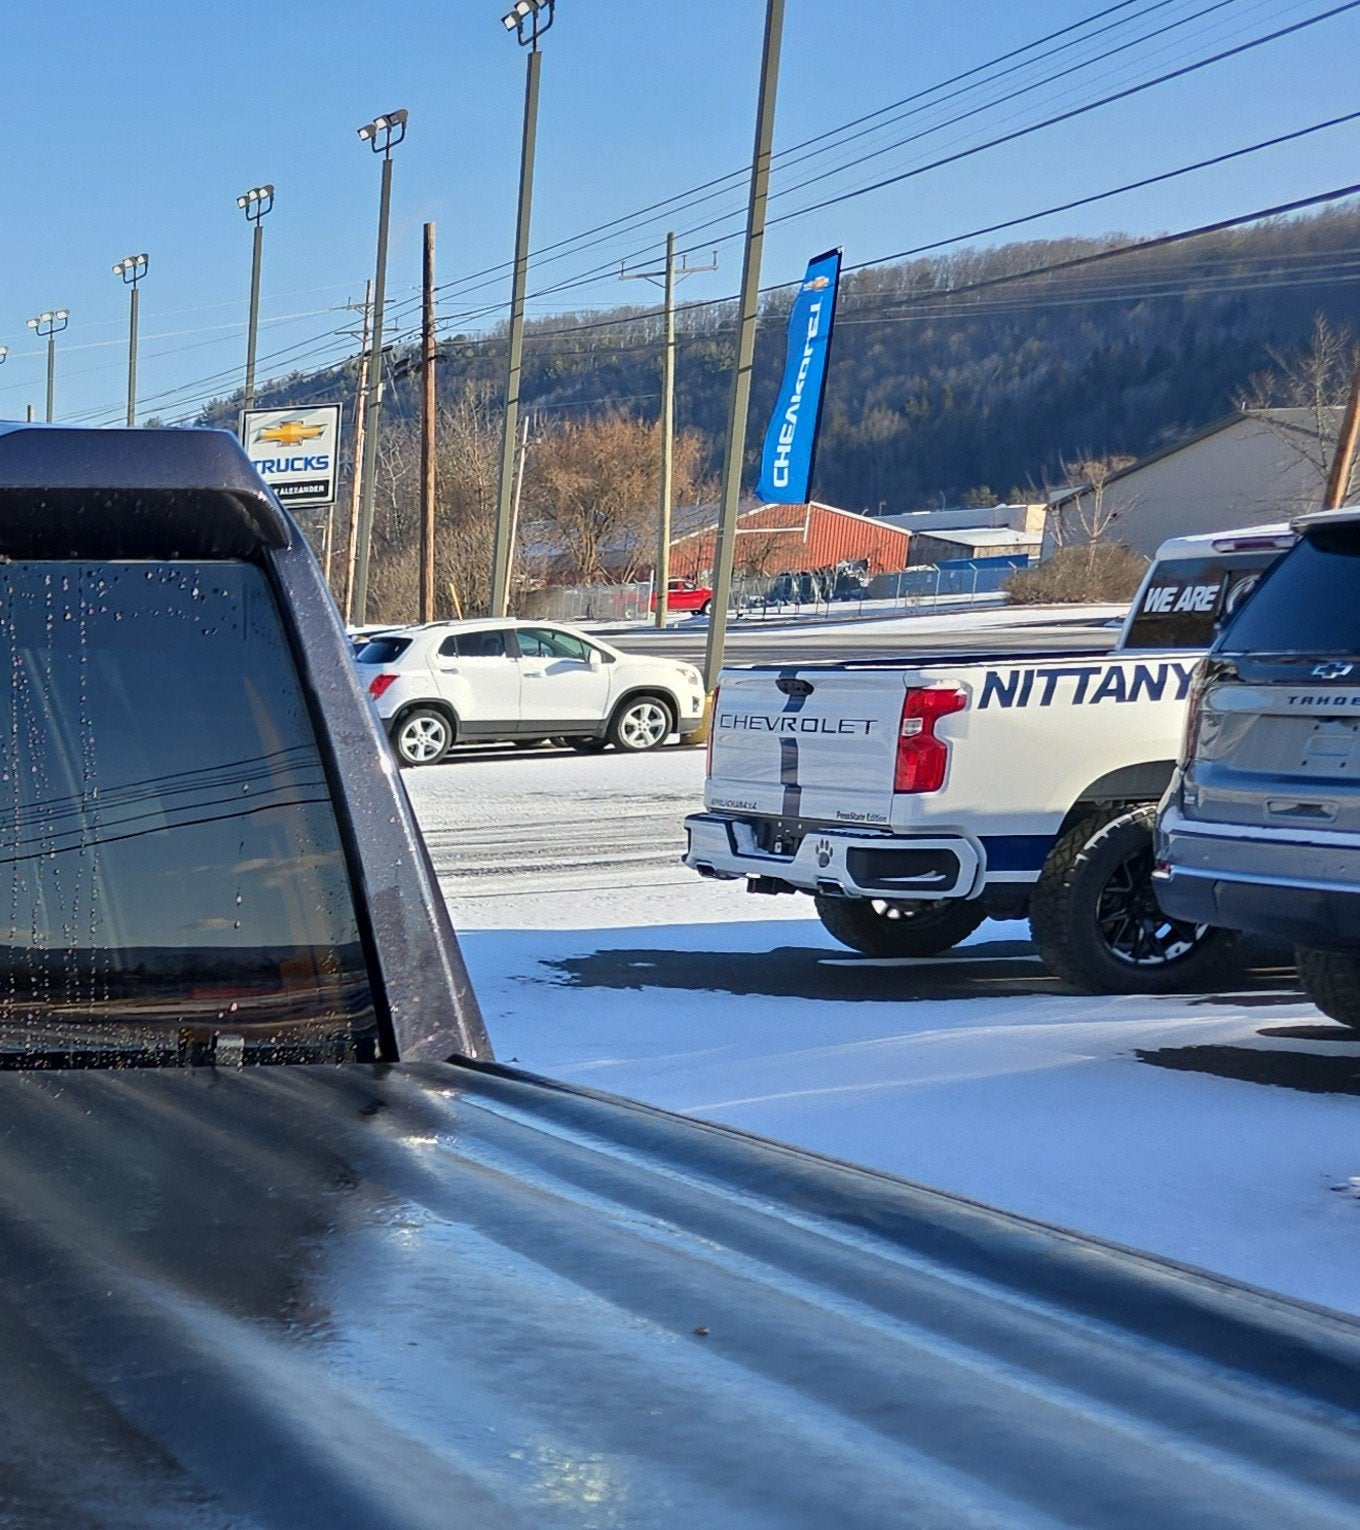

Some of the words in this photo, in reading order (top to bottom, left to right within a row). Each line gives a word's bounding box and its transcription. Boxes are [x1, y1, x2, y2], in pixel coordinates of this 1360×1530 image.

[280, 484, 325, 496] ALEXANDER
[1143, 586, 1179, 613] WE
[1173, 585, 1221, 613] ARE
[977, 662, 1195, 710] NITTANY
[719, 714, 879, 735] CHEVROLET
